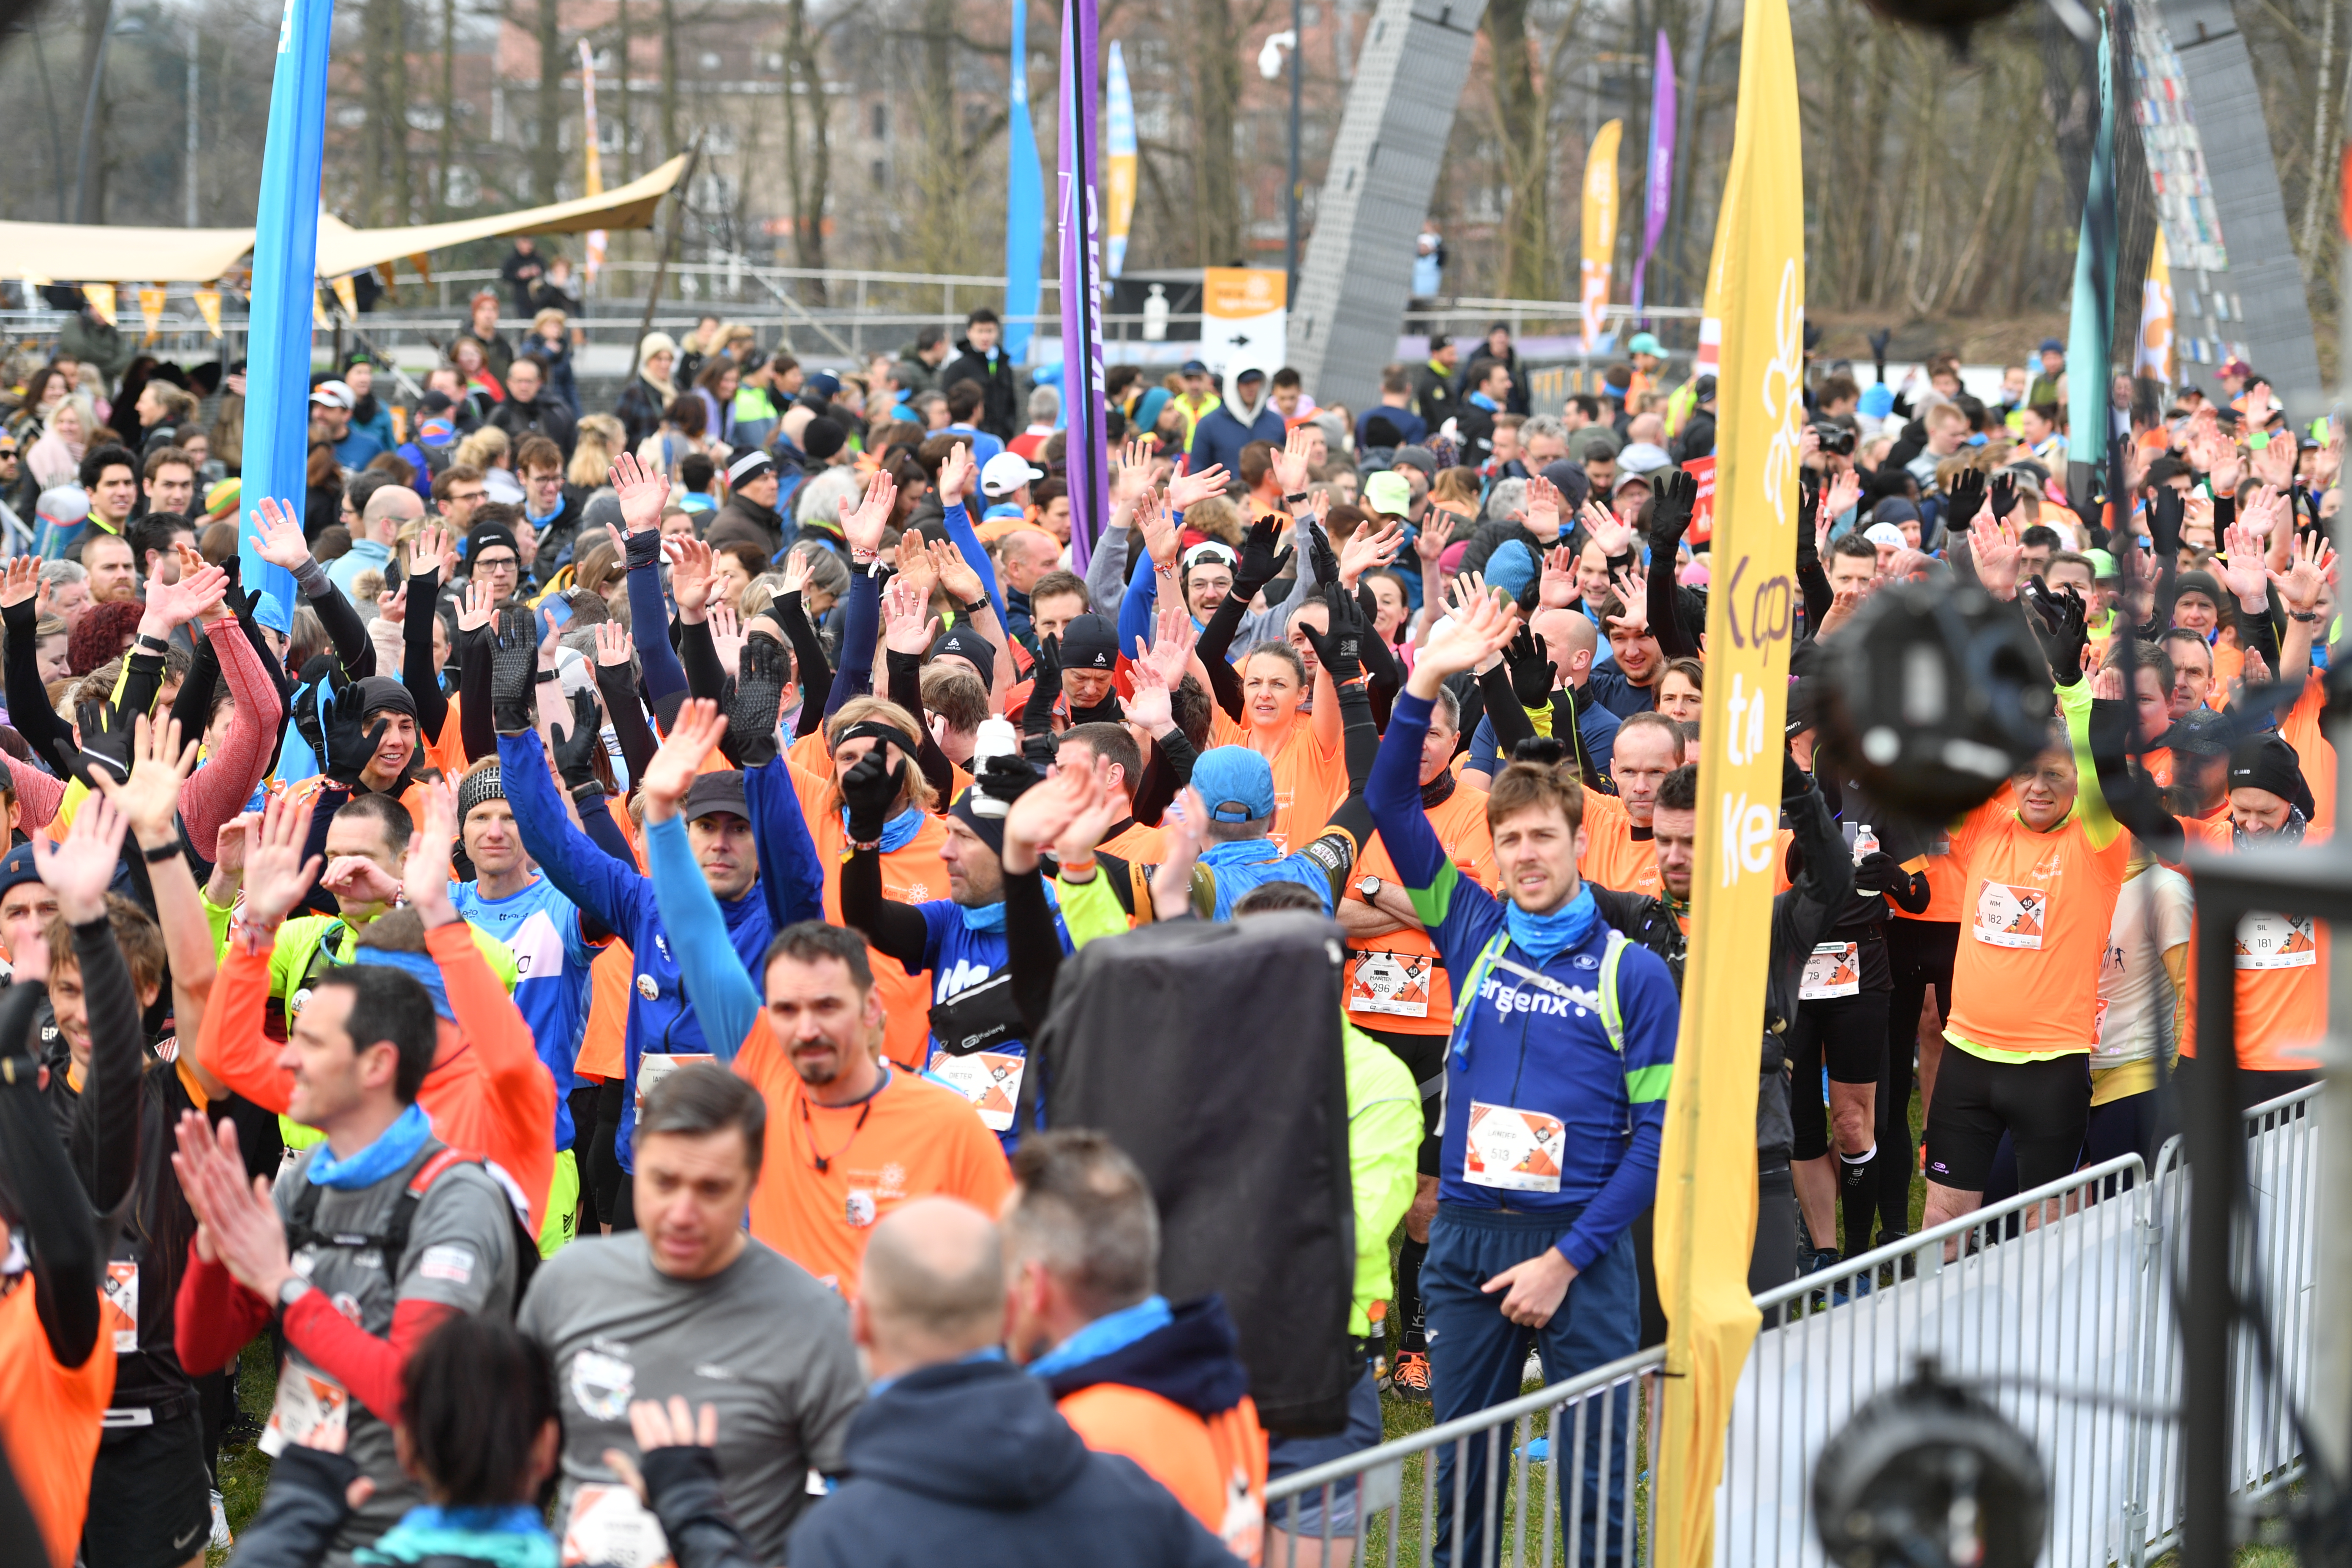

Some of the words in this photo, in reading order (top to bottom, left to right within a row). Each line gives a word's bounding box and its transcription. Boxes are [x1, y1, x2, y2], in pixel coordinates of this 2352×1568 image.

[1785, 721, 1798, 732] CRAFT
[883, 888, 898, 896] Kom
[1989, 899, 2001, 908] WIM
[1988, 913, 2002, 925] 182
[2257, 939, 2271, 948] 181
[1808, 972, 1820, 980] 79
[1372, 983, 1390, 993] 296
[1478, 977, 1568, 1017] argenx
[978, 1023, 1006, 1040] Kalenji
[949, 1072, 973, 1080] DIETER
[1487, 1128, 1517, 1140] LANDER
[1535, 1130, 1550, 1140] 40
[1490, 1148, 1510, 1161] 513
